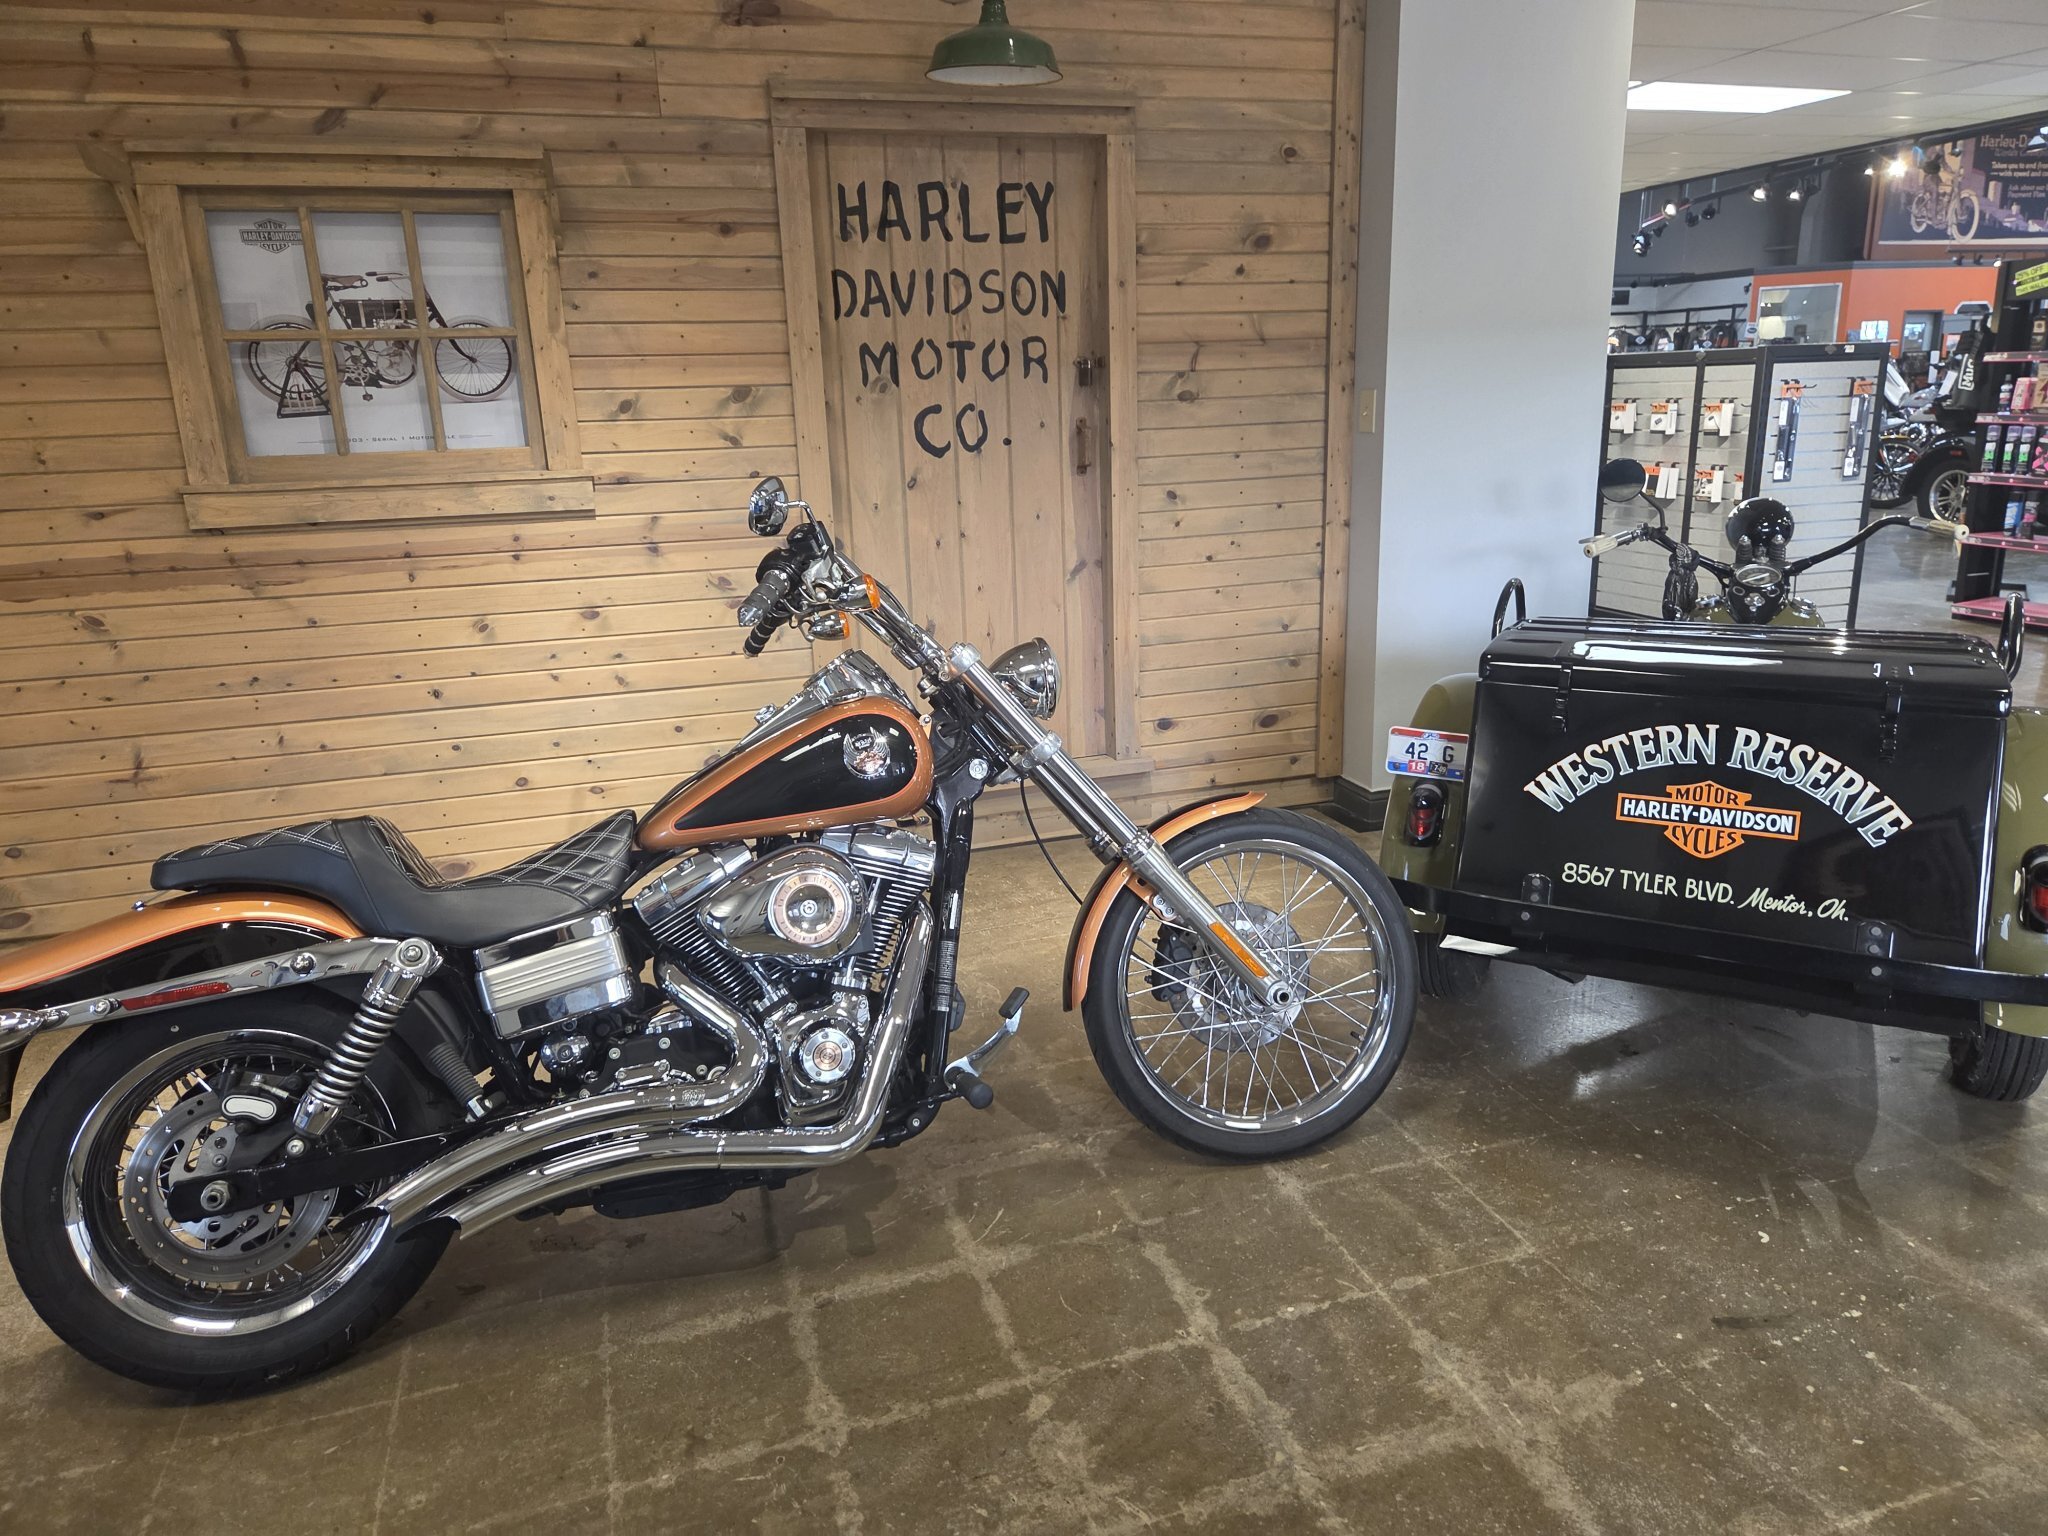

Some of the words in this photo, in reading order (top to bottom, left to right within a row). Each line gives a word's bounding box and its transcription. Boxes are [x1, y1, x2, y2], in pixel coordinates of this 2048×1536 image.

[837, 180, 1055, 244] HARLEY
[831, 268, 1066, 321] DAVIDSON
[859, 336, 1048, 388] MOTOR
[914, 403, 1012, 459] CO.
[1405, 742, 1429, 760] 42
[1442, 746, 1454, 763] G
[1410, 762, 1425, 771] 18
[1523, 723, 1720, 813] WESTERN
[1726, 726, 1913, 848] RESERVE
[1675, 782, 1739, 806] MOTOR
[1623, 798, 1795, 834] HARLEY-DAVIDSON
[1671, 825, 1737, 855] CYCLES
[1561, 862, 1615, 888] 8567
[1619, 869, 1678, 897] TYLER
[1684, 878, 1735, 905] BLVD.
[1737, 887, 1814, 918] Mentor,
[1817, 898, 1849, 922] Oh.
